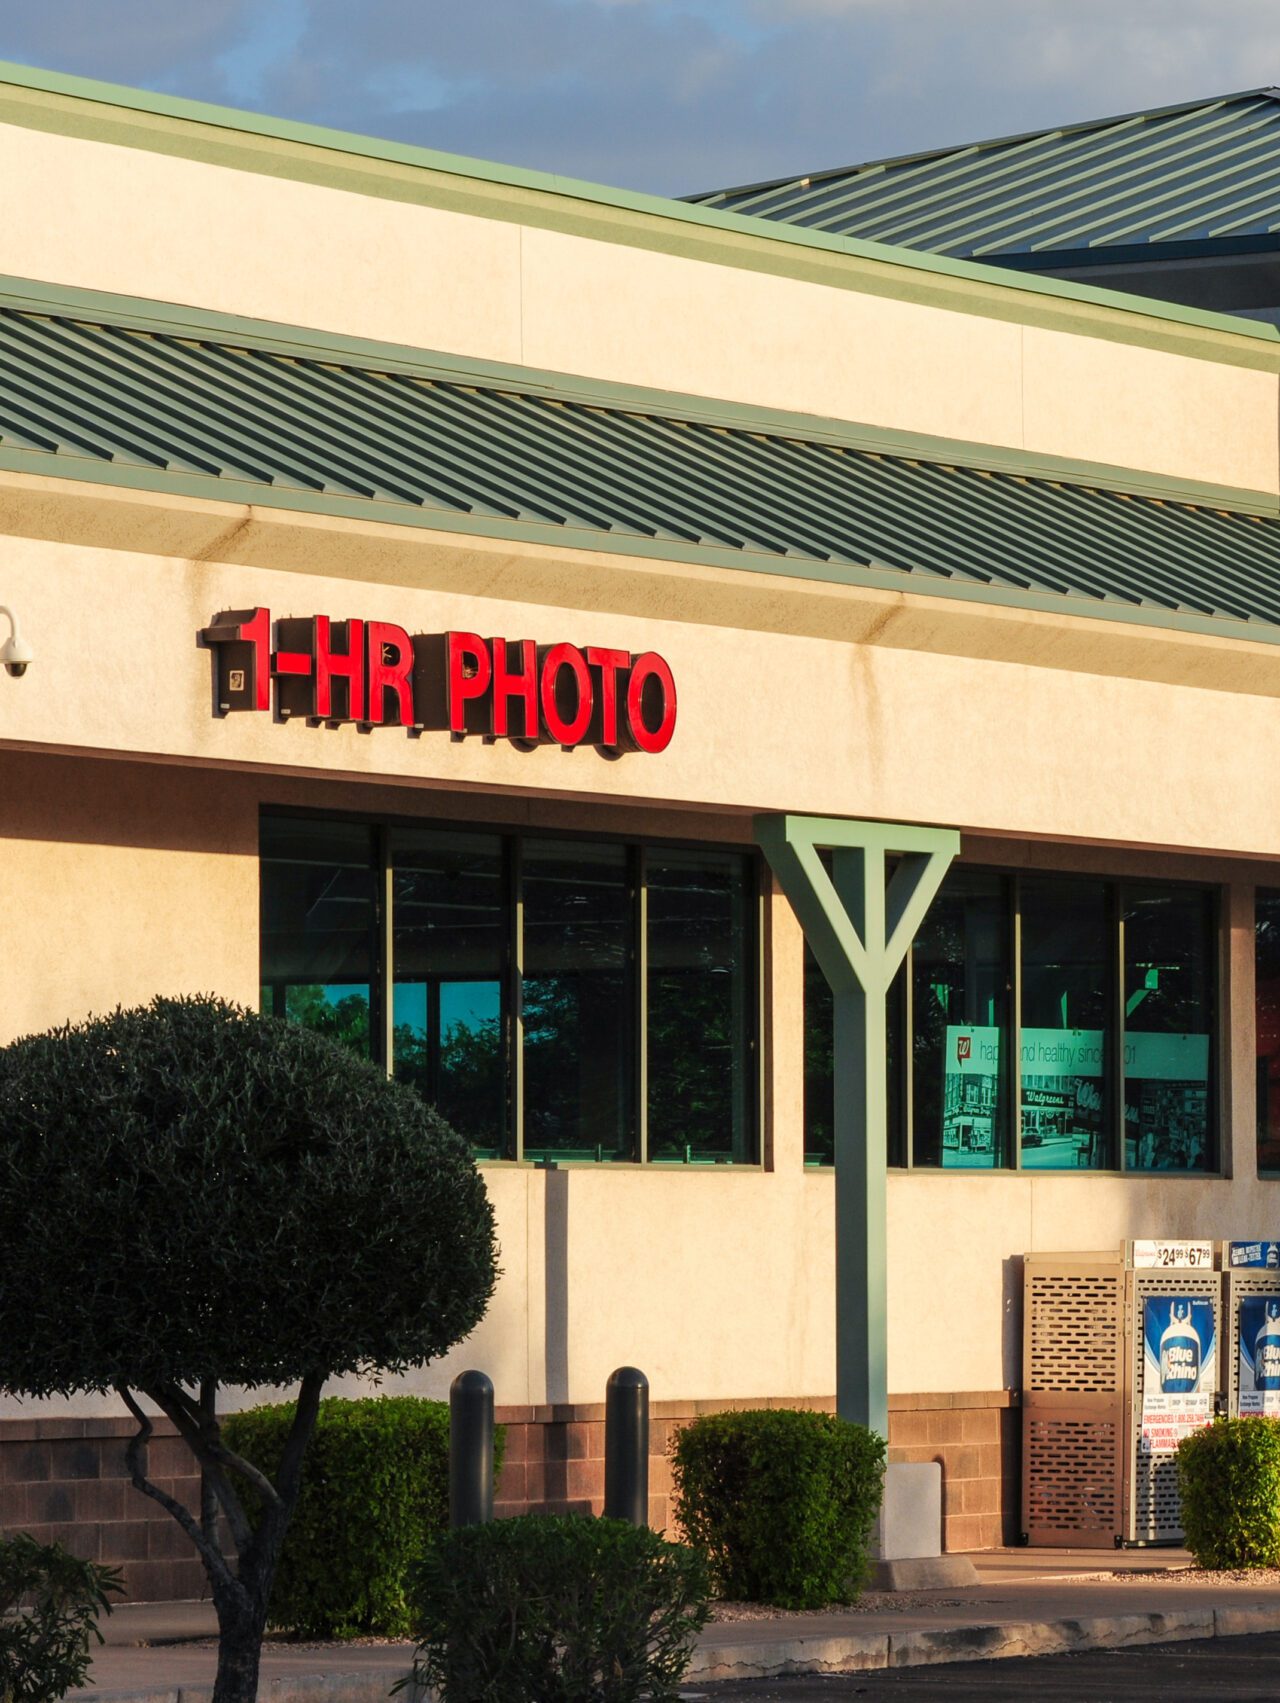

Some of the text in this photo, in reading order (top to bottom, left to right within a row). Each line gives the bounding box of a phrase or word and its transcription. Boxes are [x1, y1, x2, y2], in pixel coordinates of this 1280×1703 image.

[222, 607, 677, 753] 1-HR PHOTO
[1020, 1041, 1036, 1062] nd
[1038, 1040, 1075, 1068] healthy
[1168, 1346, 1193, 1362] Blue
